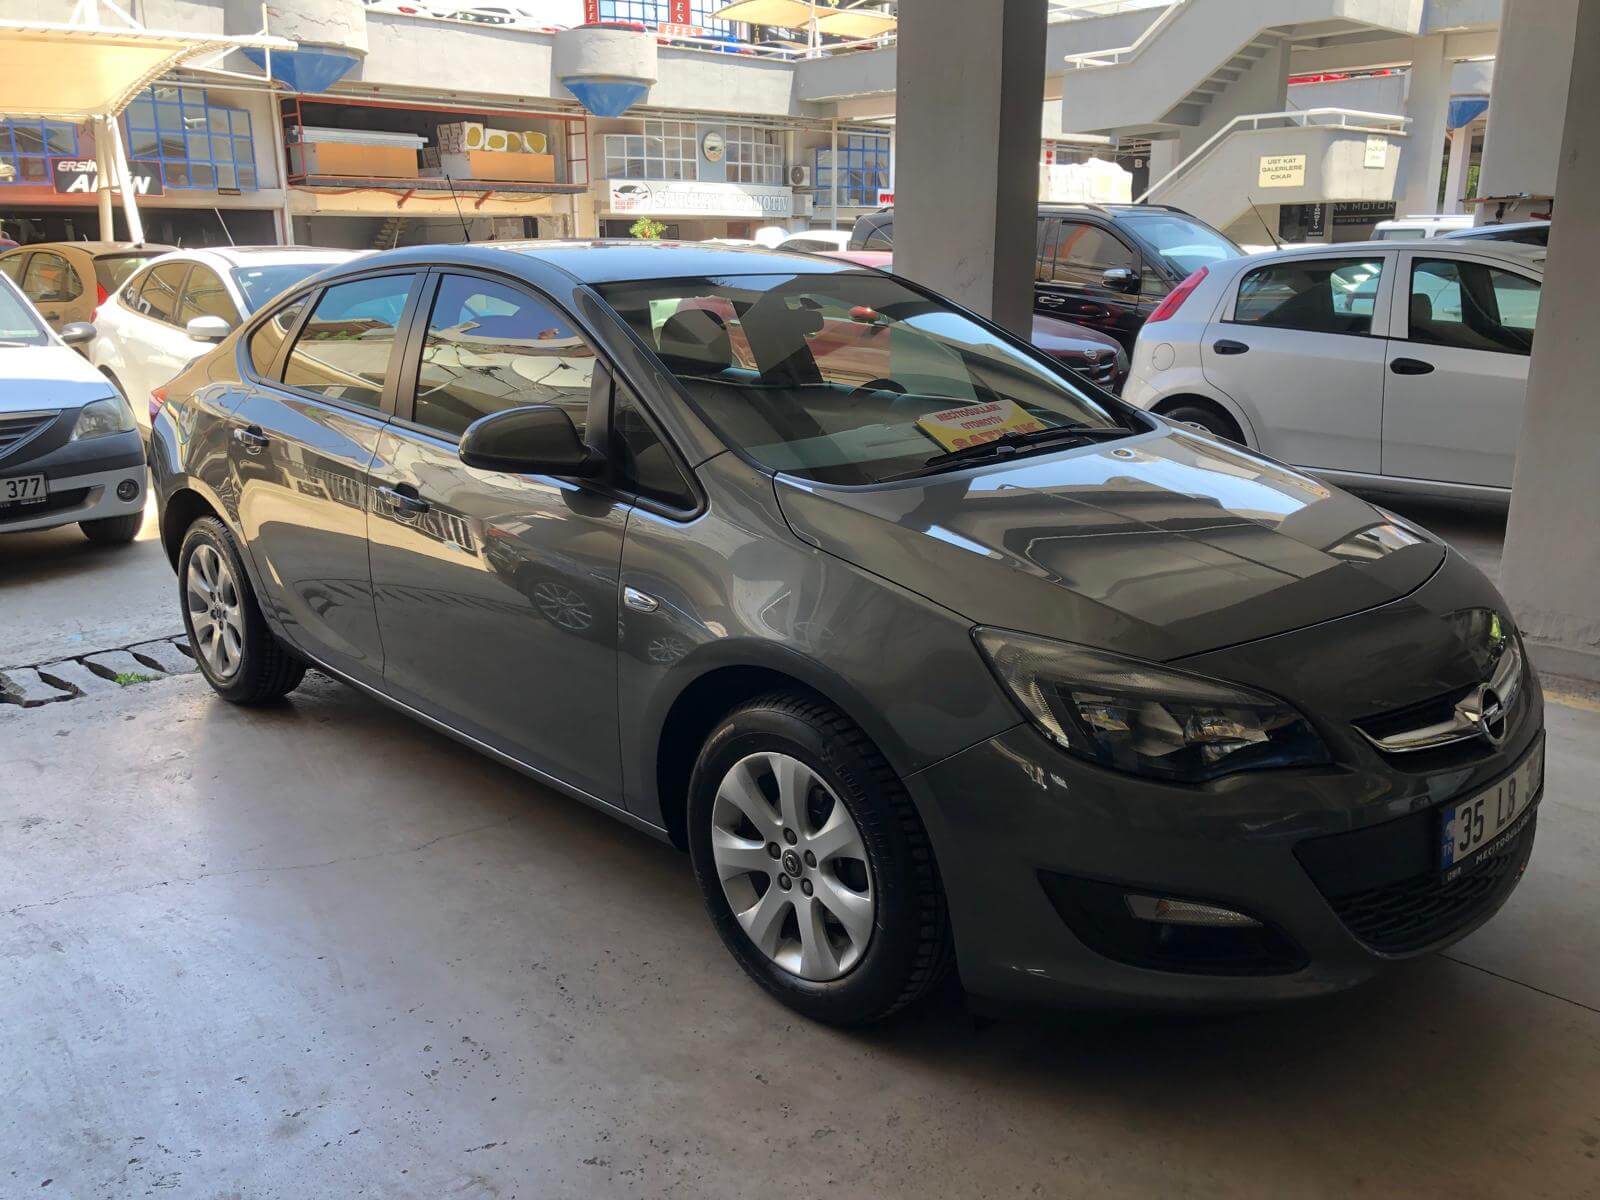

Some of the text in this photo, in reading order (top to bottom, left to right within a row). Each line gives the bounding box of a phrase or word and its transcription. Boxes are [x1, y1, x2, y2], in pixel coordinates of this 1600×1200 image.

[1352, 200, 1395, 211] MOTOR
[6, 477, 40, 499] 377
[1460, 799, 1484, 852] 35
[1442, 842, 1453, 857] TR
